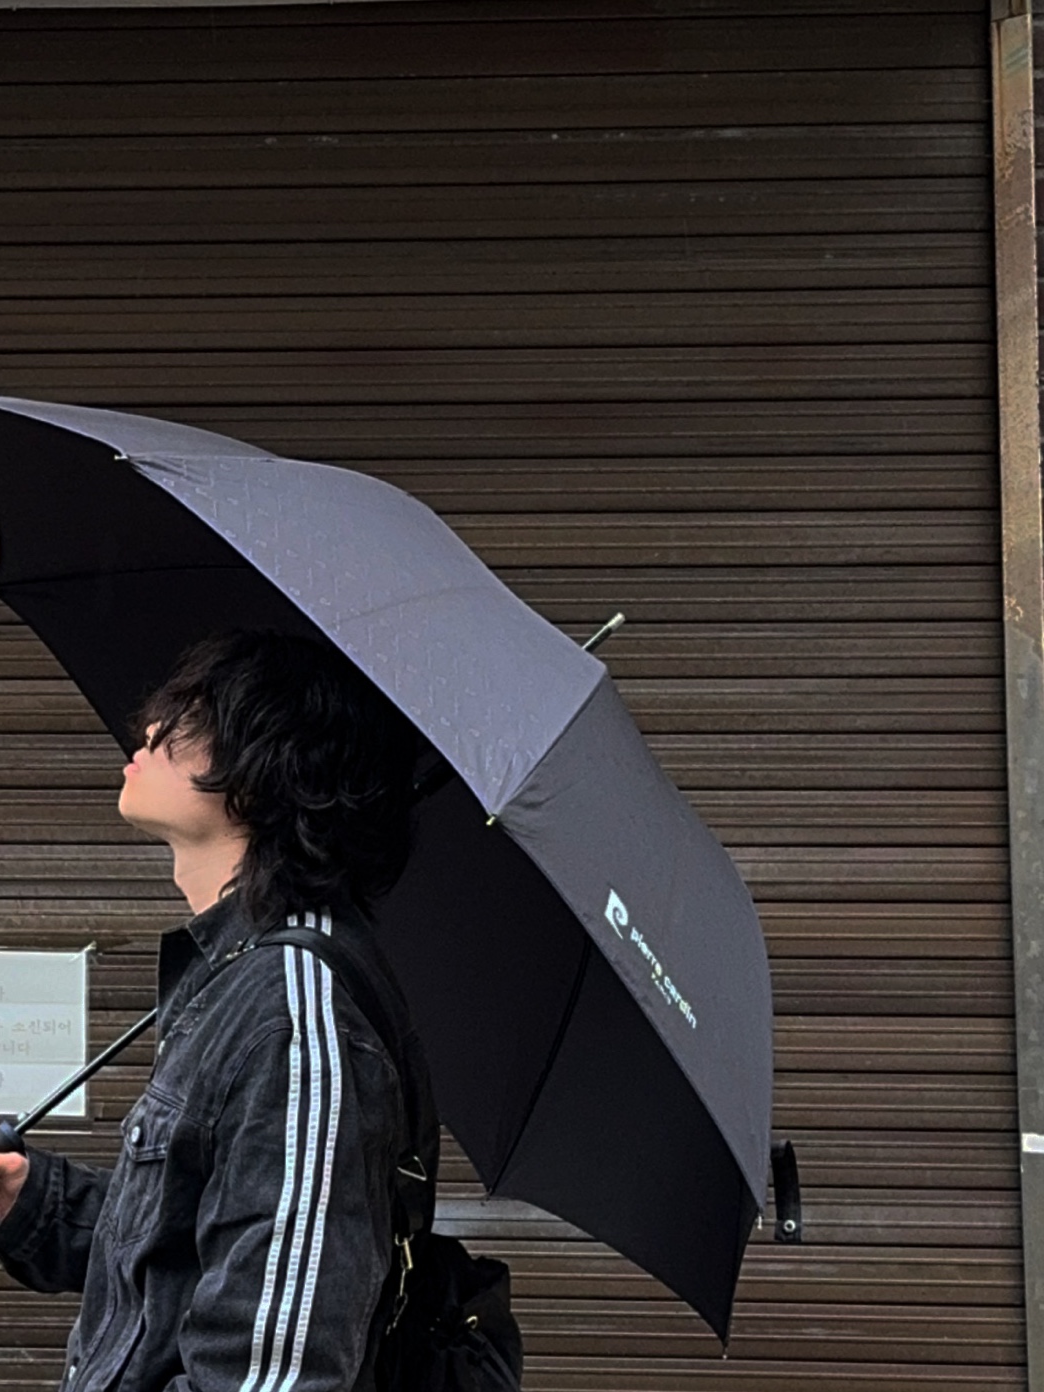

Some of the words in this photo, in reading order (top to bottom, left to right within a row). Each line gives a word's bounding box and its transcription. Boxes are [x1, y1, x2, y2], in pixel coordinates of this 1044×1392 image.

[630, 926, 662, 976] pierre
[664, 975, 696, 1029] cardin
[11, 1019, 72, 1035] 소진되어
